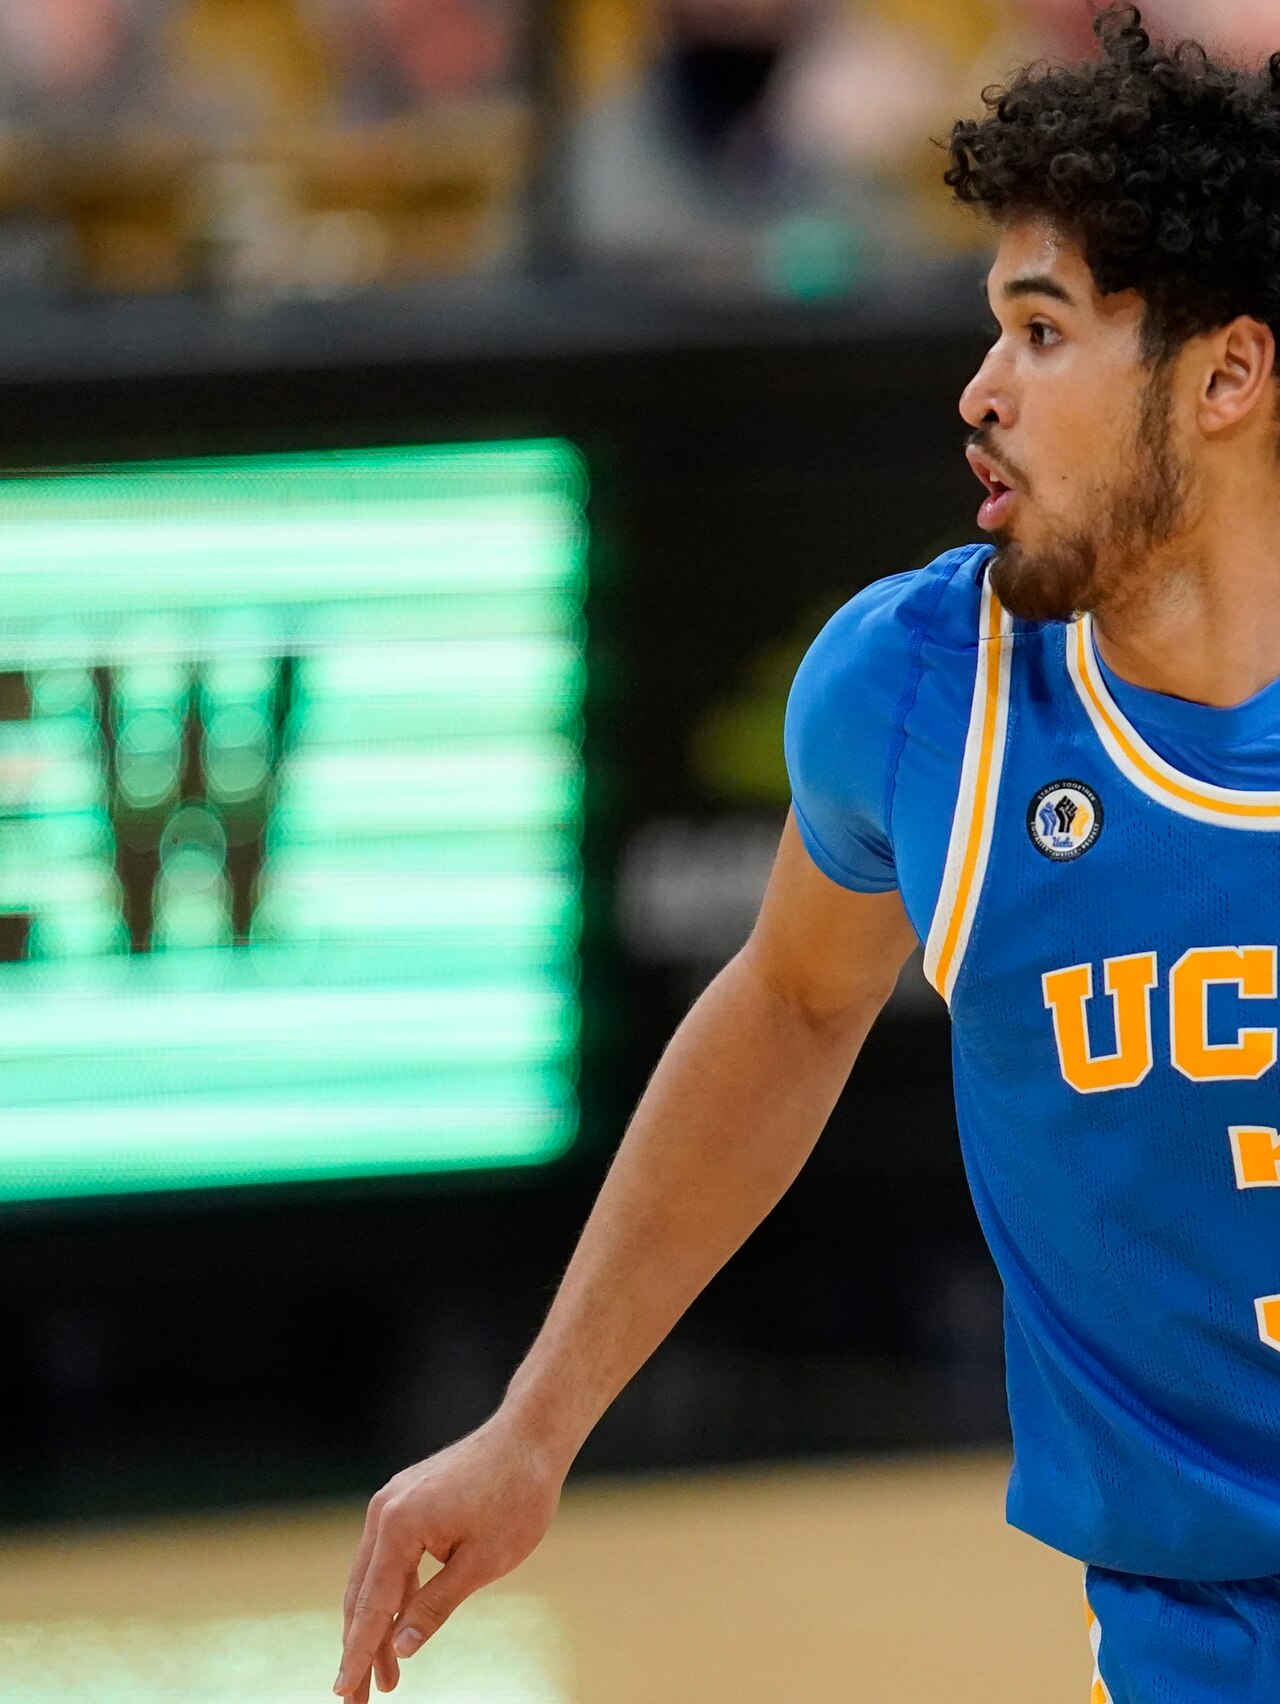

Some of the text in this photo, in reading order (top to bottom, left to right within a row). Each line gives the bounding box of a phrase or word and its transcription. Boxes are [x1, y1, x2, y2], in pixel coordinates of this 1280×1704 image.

[1037, 782, 1096, 801] STAND TOGETHER
[1081, 822, 1100, 849] RESPECT
